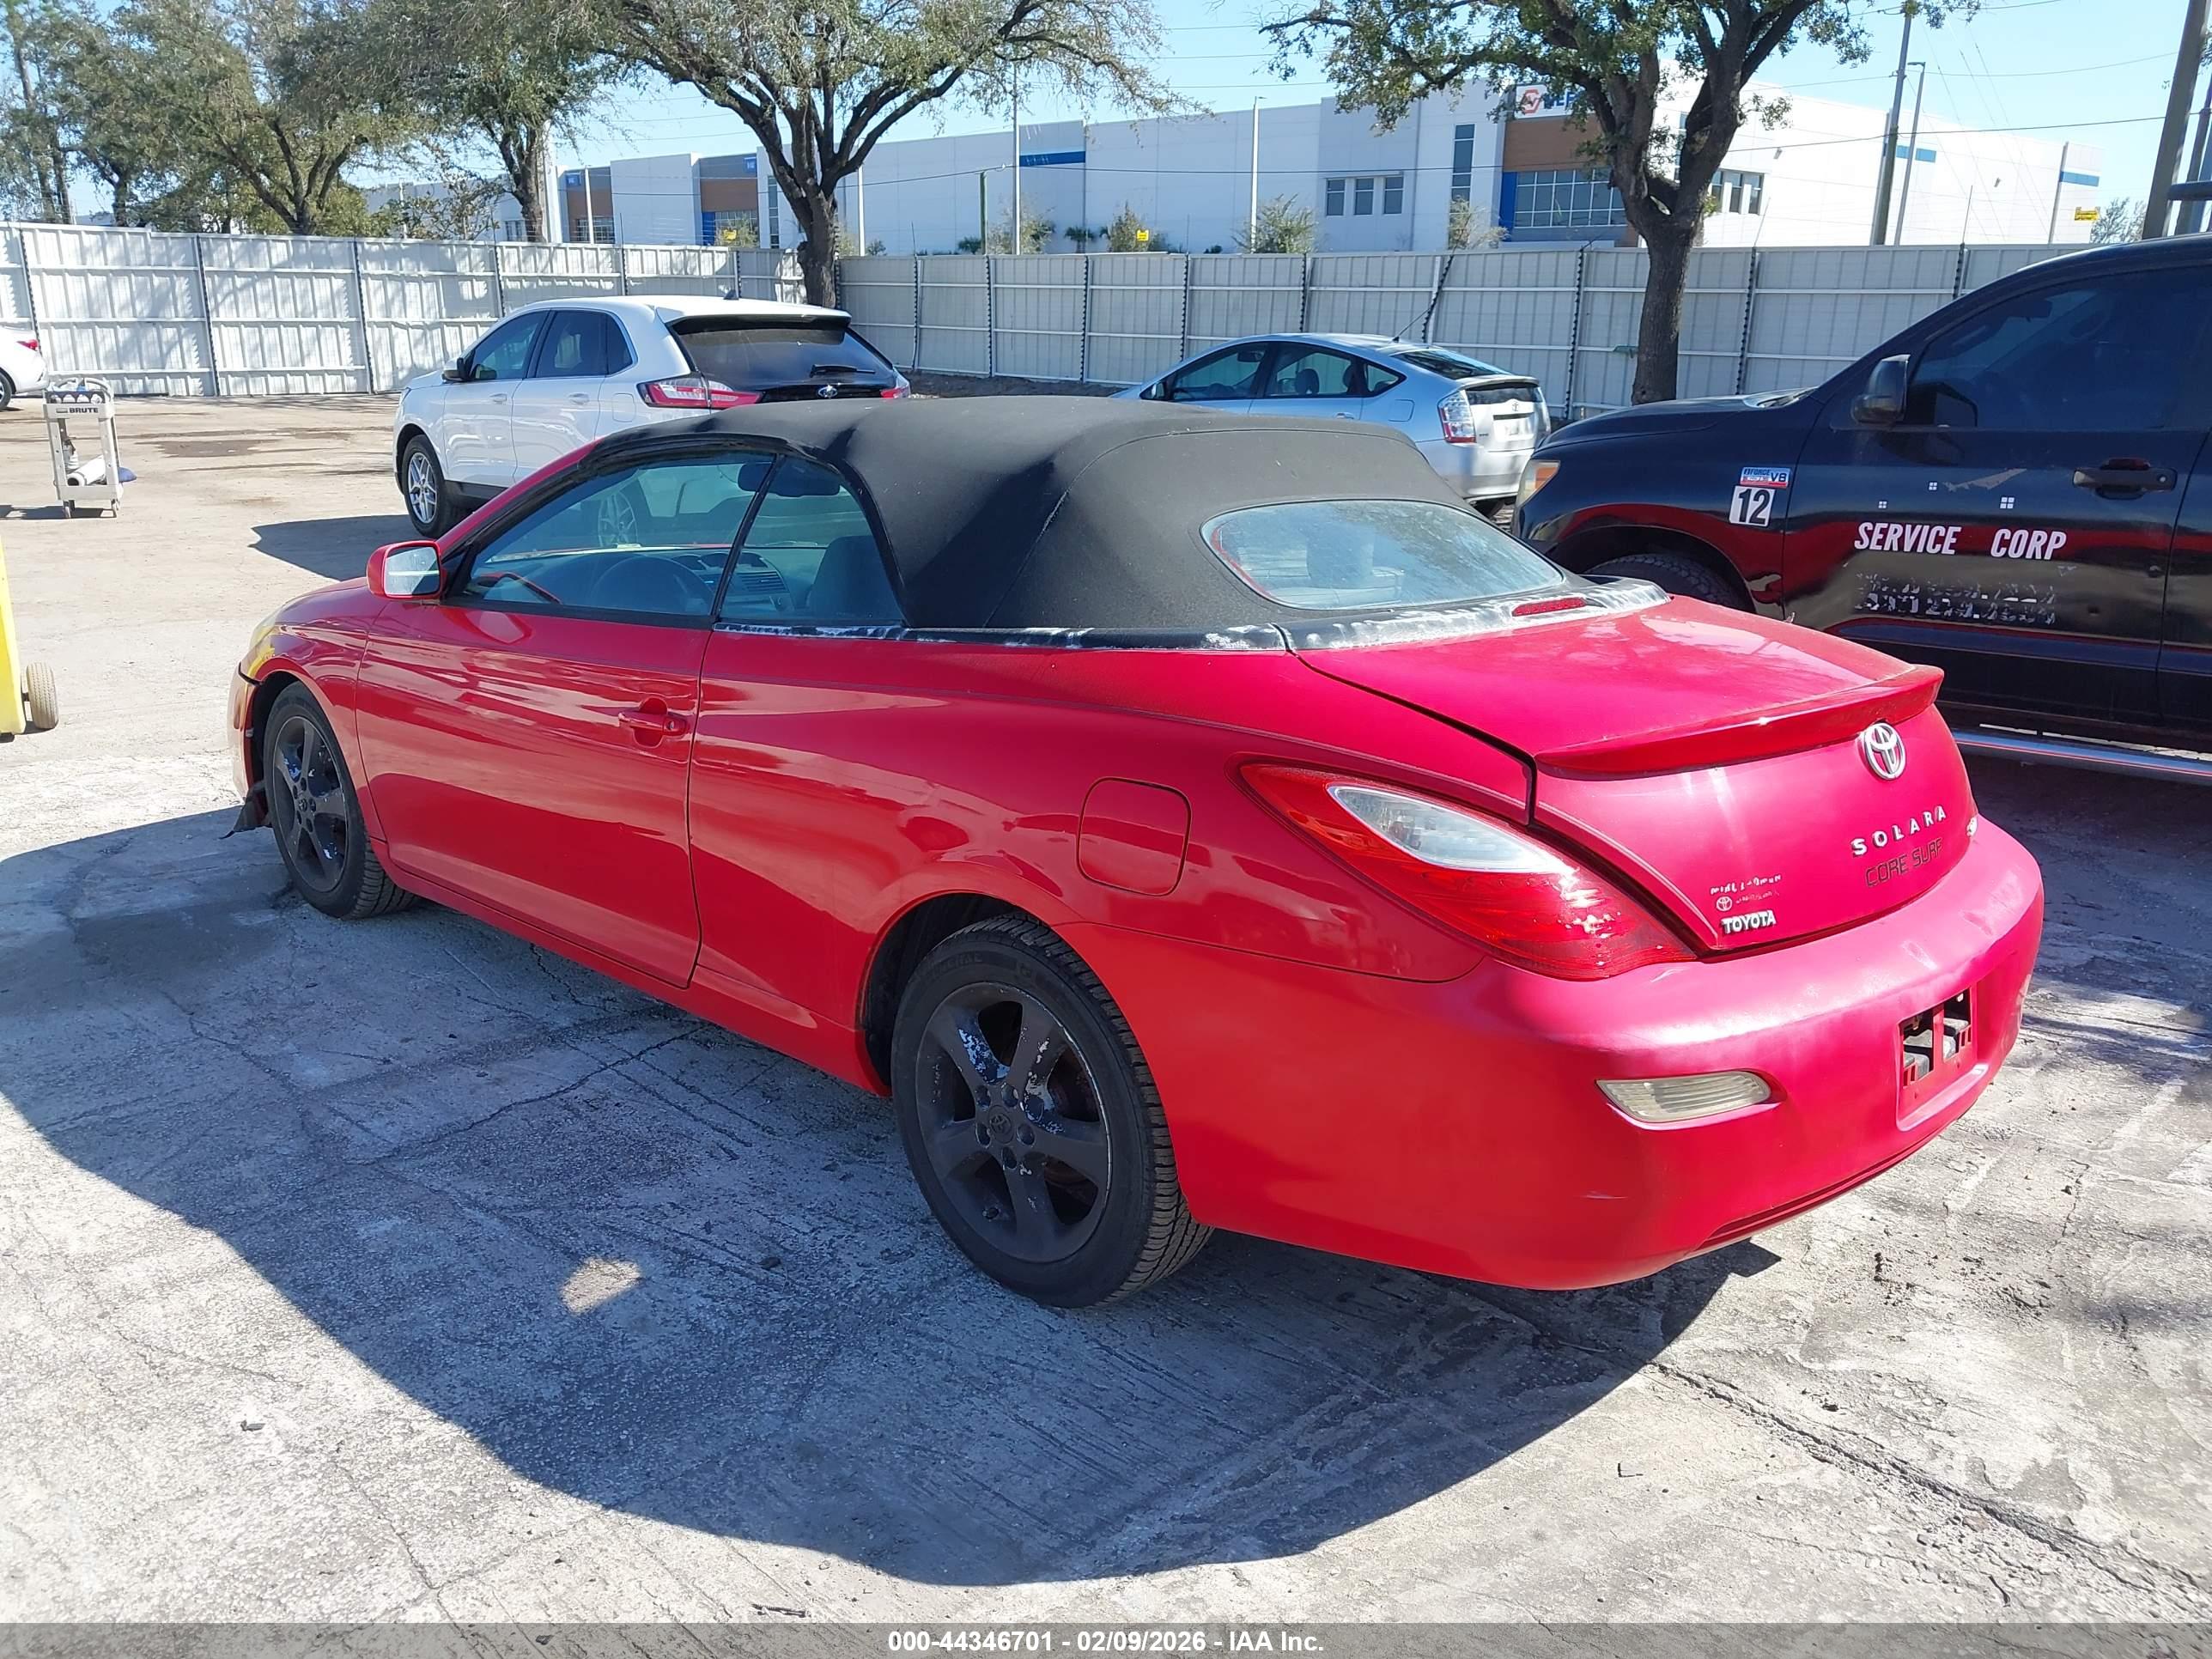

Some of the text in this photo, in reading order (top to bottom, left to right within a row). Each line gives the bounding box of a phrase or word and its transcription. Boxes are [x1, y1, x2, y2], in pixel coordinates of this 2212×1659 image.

[1770, 471, 1788, 483] V8
[1738, 488, 1771, 526] 12
[1854, 521, 2068, 561] SERVICE CORP
[1850, 805, 1947, 857] SOLARA
[1865, 838, 1943, 888] CORE SURF
[1721, 909, 1778, 935] TOYOTA
